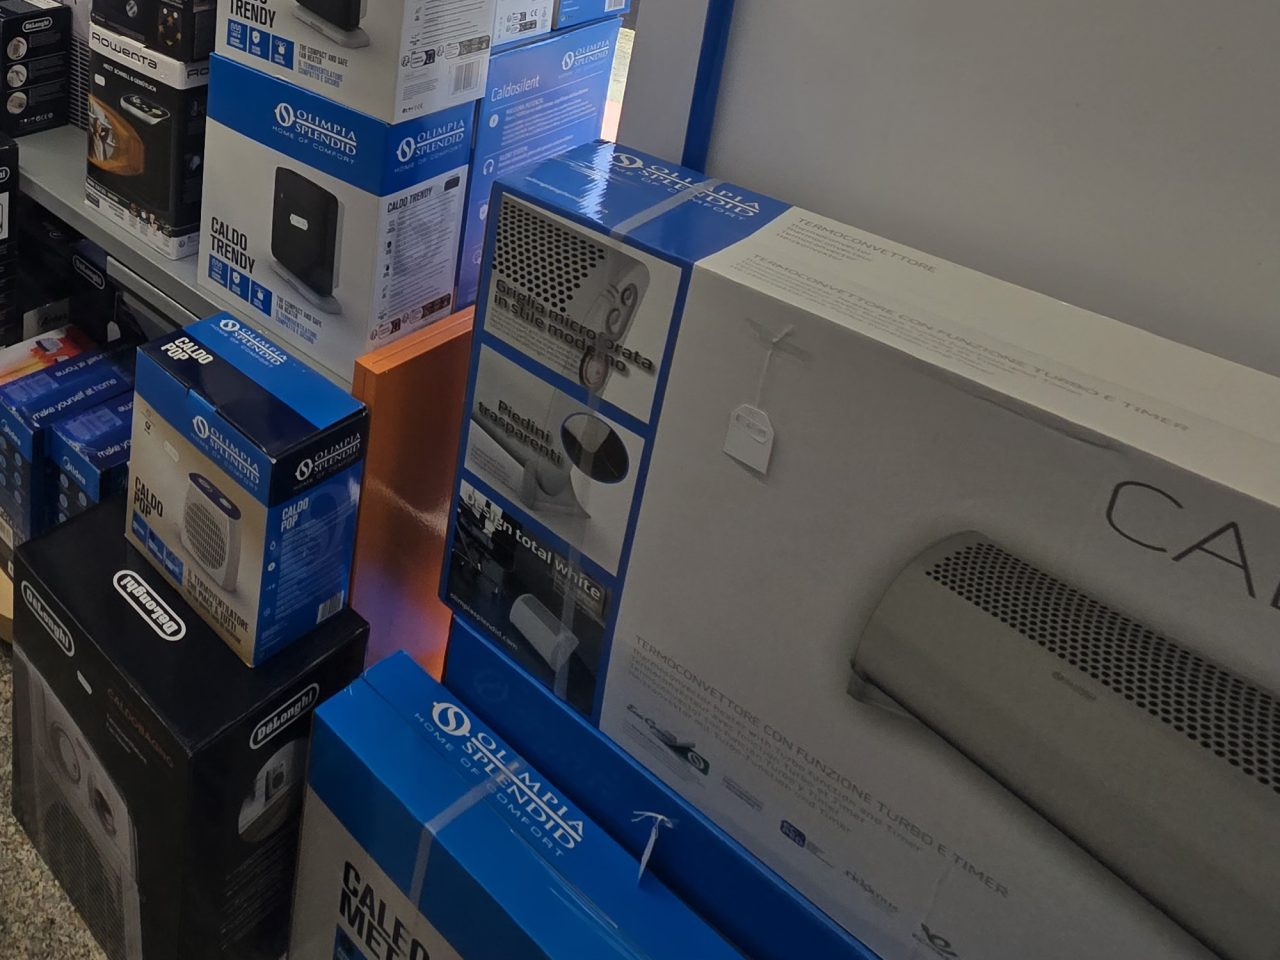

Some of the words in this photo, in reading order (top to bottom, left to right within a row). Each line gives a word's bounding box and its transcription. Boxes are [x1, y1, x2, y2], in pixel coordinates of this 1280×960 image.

[575, 50, 608, 66] SPLENDID
[576, 40, 609, 56] OLIMPIA
[491, 75, 539, 102] Caldosilent
[295, 123, 356, 156] SPLENDID
[297, 109, 356, 141] OLIMPIA
[417, 119, 465, 142] OLIMPIA
[273, 125, 294, 139] HOME
[299, 136, 308, 144] OF
[313, 143, 355, 165] COMFORT
[415, 132, 464, 158] SPLENDID
[387, 197, 408, 213] CALDO
[409, 187, 432, 205] TRENDY
[211, 216, 247, 252] CALDO
[799, 217, 936, 273] TERMOCONVETTORE
[210, 234, 255, 274] TRENDY
[494, 293, 508, 309] in
[511, 303, 544, 328] stile
[548, 325, 627, 372] modeno
[496, 279, 546, 315] Griglia
[548, 309, 653, 371] microorata
[753, 254, 893, 316] TERMOCONVETTORE
[899, 313, 933, 331] CON
[1122, 401, 1190, 431] TIMER
[161, 343, 190, 361] POP
[174, 337, 214, 364] CALDO
[232, 330, 281, 366] SPLENDID
[241, 328, 287, 361] OLIMPIA
[32, 406, 56, 421] make
[55, 391, 85, 413] yourself
[86, 385, 94, 396] at
[94, 377, 118, 391] home
[478, 401, 562, 466] trasparenti
[498, 400, 551, 442] Piedini
[209, 428, 260, 471] OLIMPIA
[209, 439, 260, 485] SPLENDID
[314, 433, 361, 460] OLIMPIA
[314, 443, 361, 474] SPLENDID
[133, 492, 152, 518] POP
[135, 477, 164, 518] CALDO
[282, 497, 309, 521] CALDO
[281, 515, 298, 532] POP
[464, 486, 513, 537] Design
[516, 528, 552, 564] total
[554, 558, 601, 600] white
[1106, 481, 1280, 610] CA
[414, 712, 454, 752] HOME
[460, 758, 480, 776] OF
[486, 782, 564, 858] COMFORT
[477, 732, 584, 837] OLIMPIA
[636, 635, 760, 726] TERMOCONVETTORE
[763, 724, 793, 750] CON
[797, 746, 871, 803] FUNZIONE
[877, 801, 934, 846] TURBO
[937, 844, 947, 858] E
[953, 852, 1008, 898] TIMER
[462, 741, 576, 850] SPLENDID
